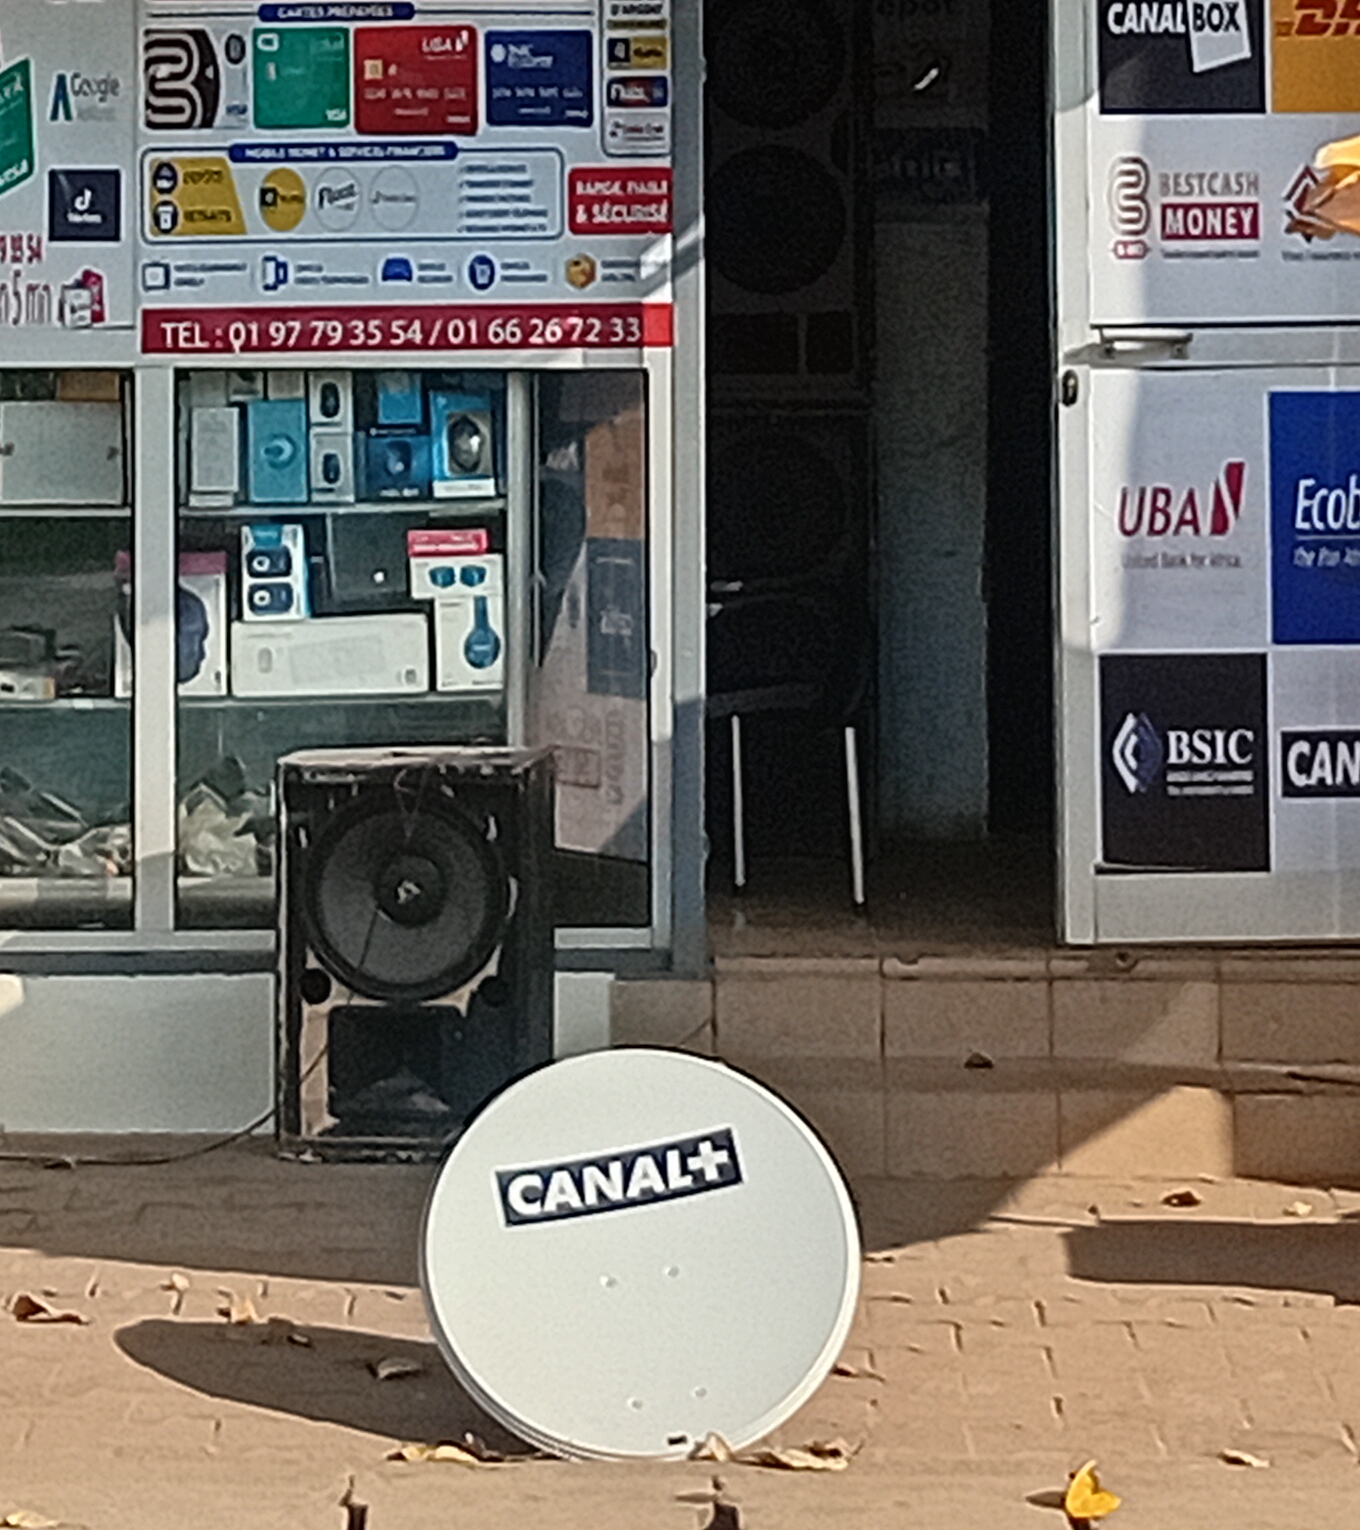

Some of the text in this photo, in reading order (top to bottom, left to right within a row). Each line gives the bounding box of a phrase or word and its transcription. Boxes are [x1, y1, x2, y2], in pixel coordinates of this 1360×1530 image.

[1159, 172, 1260, 197] BESTCASH
[575, 200, 669, 223] & SÉCURISÉ
[1164, 206, 1255, 236] MONEY
[228, 321, 260, 347] 01
[269, 321, 302, 347] 97
[309, 320, 343, 346] 79
[350, 320, 382, 345] 35
[390, 320, 423, 345] 54
[448, 319, 478, 344] 01
[487, 319, 522, 343] 66
[529, 318, 562, 343] 26
[568, 317, 601, 343] 72
[610, 317, 642, 342] 33
[1117, 485, 1201, 538] UBA
[1167, 728, 1255, 765] BSIC
[506, 1140, 730, 1216] CANAL+
